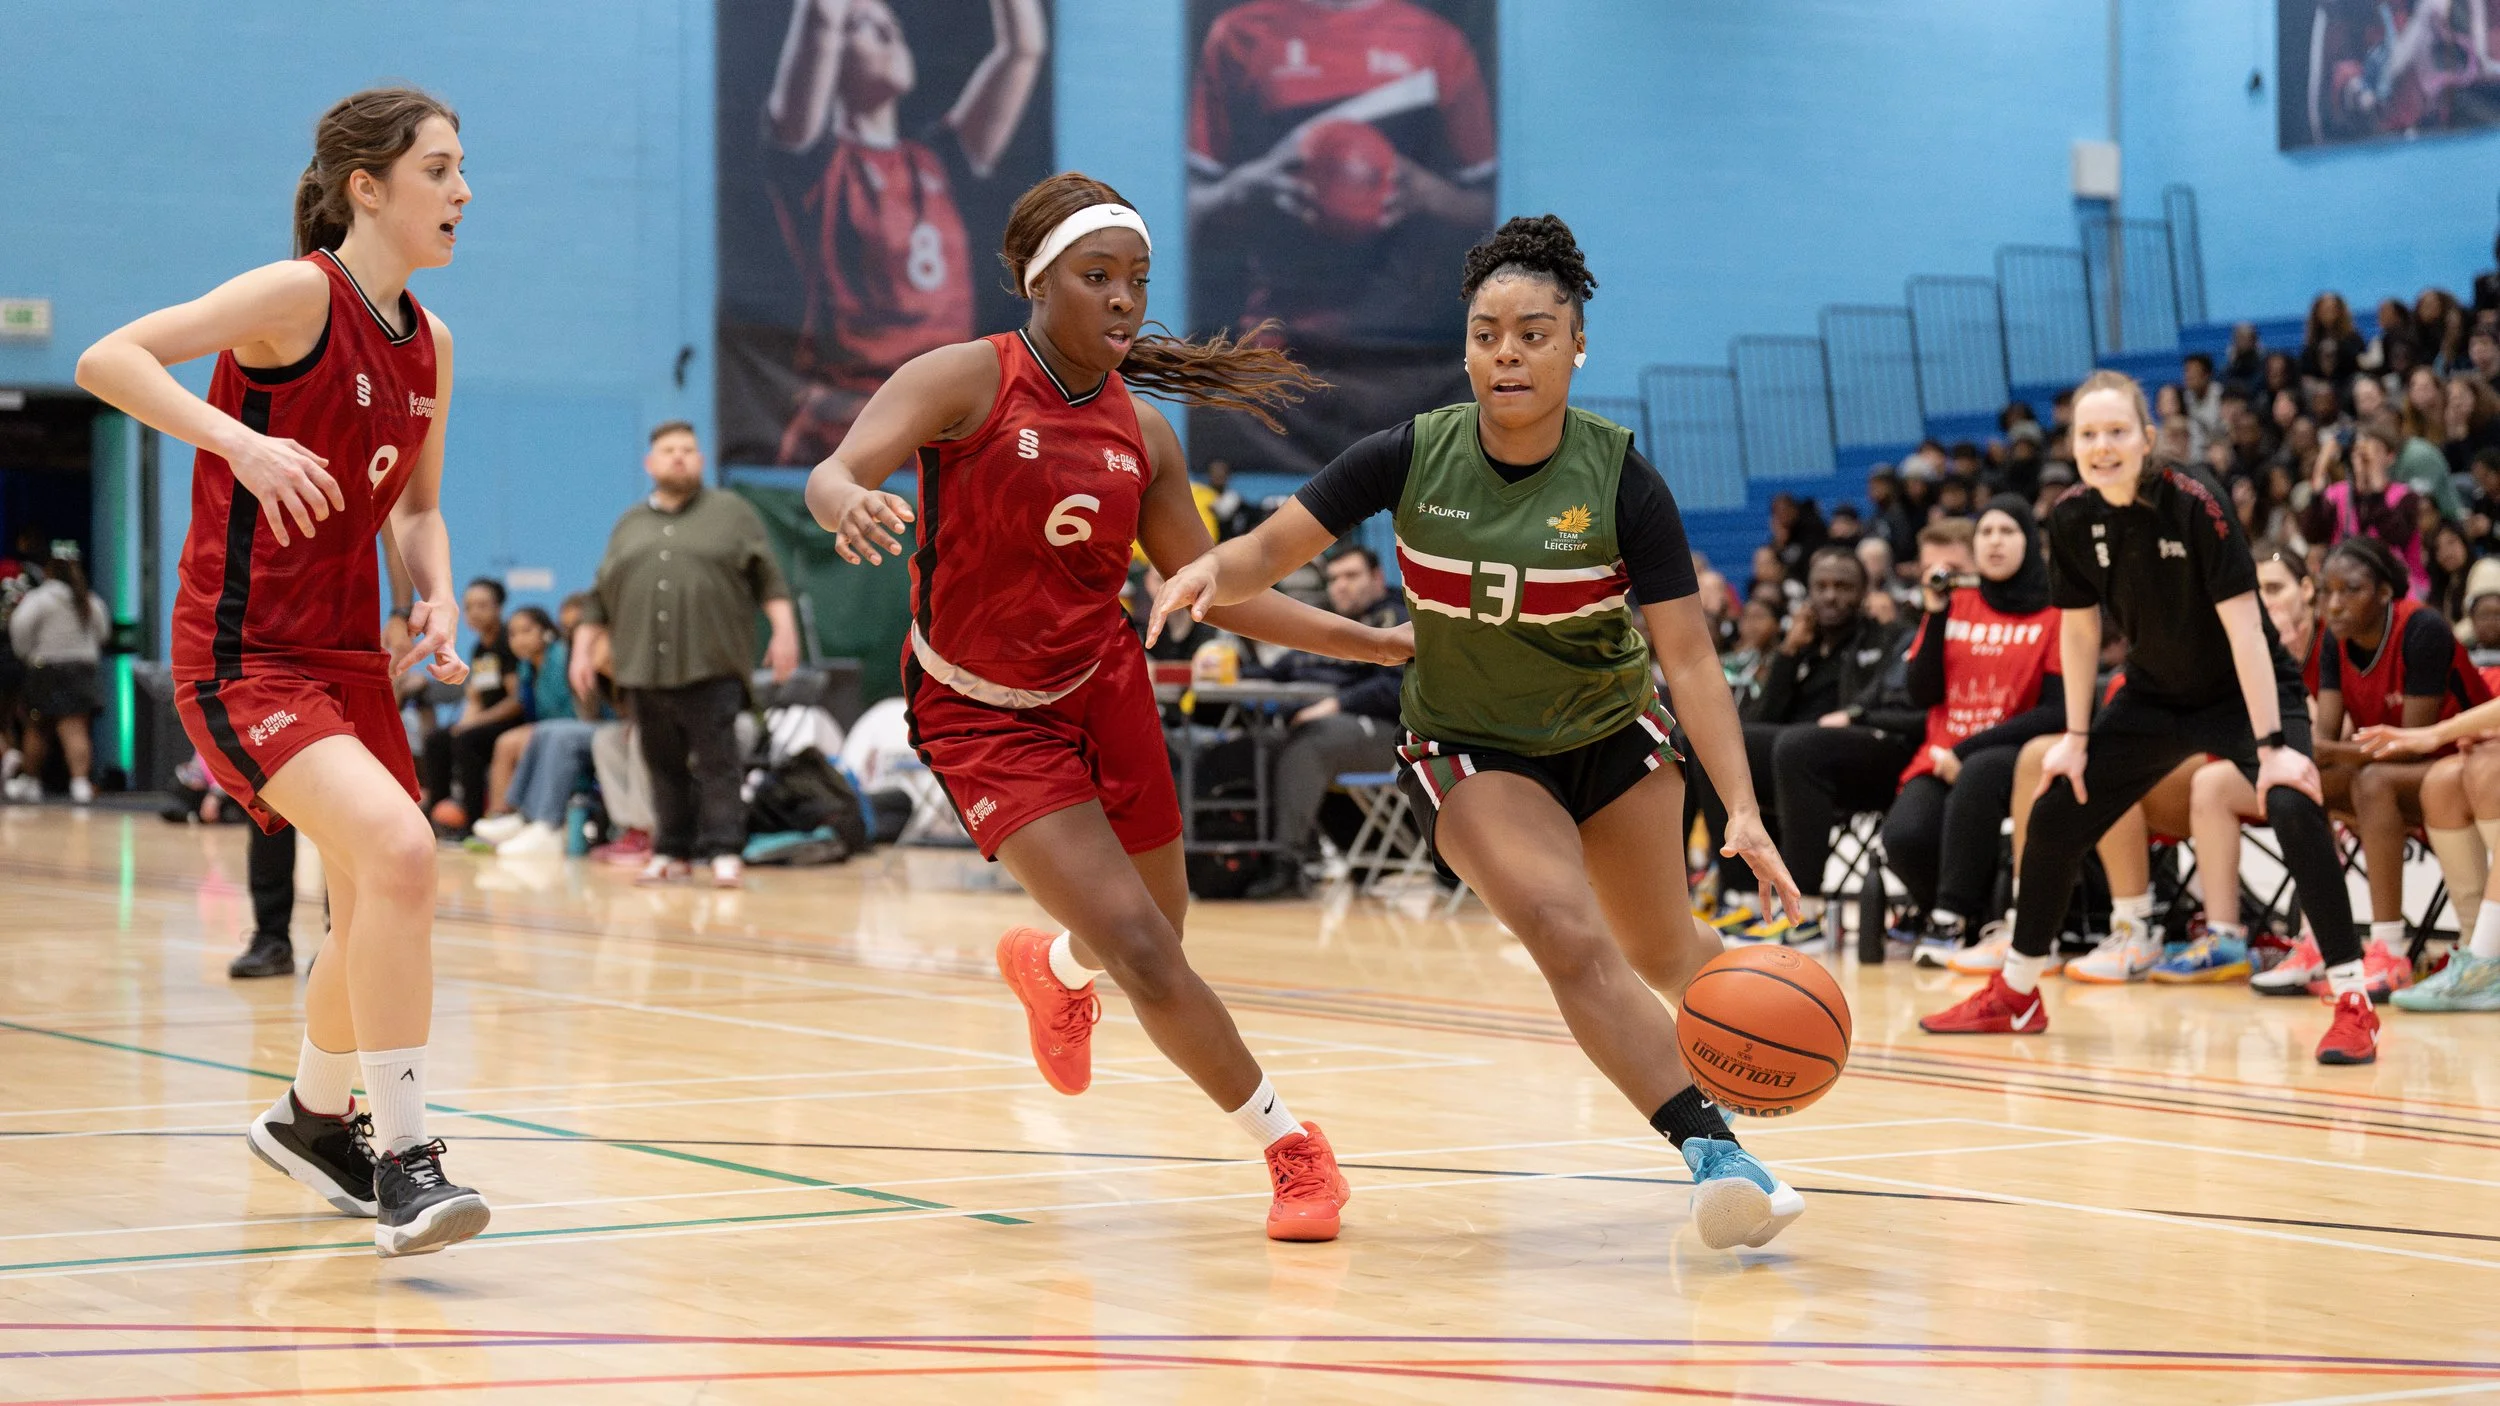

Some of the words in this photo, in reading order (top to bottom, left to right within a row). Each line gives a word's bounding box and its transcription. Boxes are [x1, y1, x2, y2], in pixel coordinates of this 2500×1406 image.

[907, 222, 947, 291] 8
[1044, 493, 1100, 547] 6
[1428, 504, 1471, 521] KUKRI
[1544, 540, 1588, 551] LEICESTER
[1559, 531, 1579, 540] TEAM
[1477, 561, 1518, 626] 3
[262, 709, 287, 729] DMU
[267, 713, 298, 736] SPORT
[973, 796, 989, 814] DMU
[977, 800, 997, 822] SPORT
[1692, 1041, 1797, 1089] EVOLUTION
